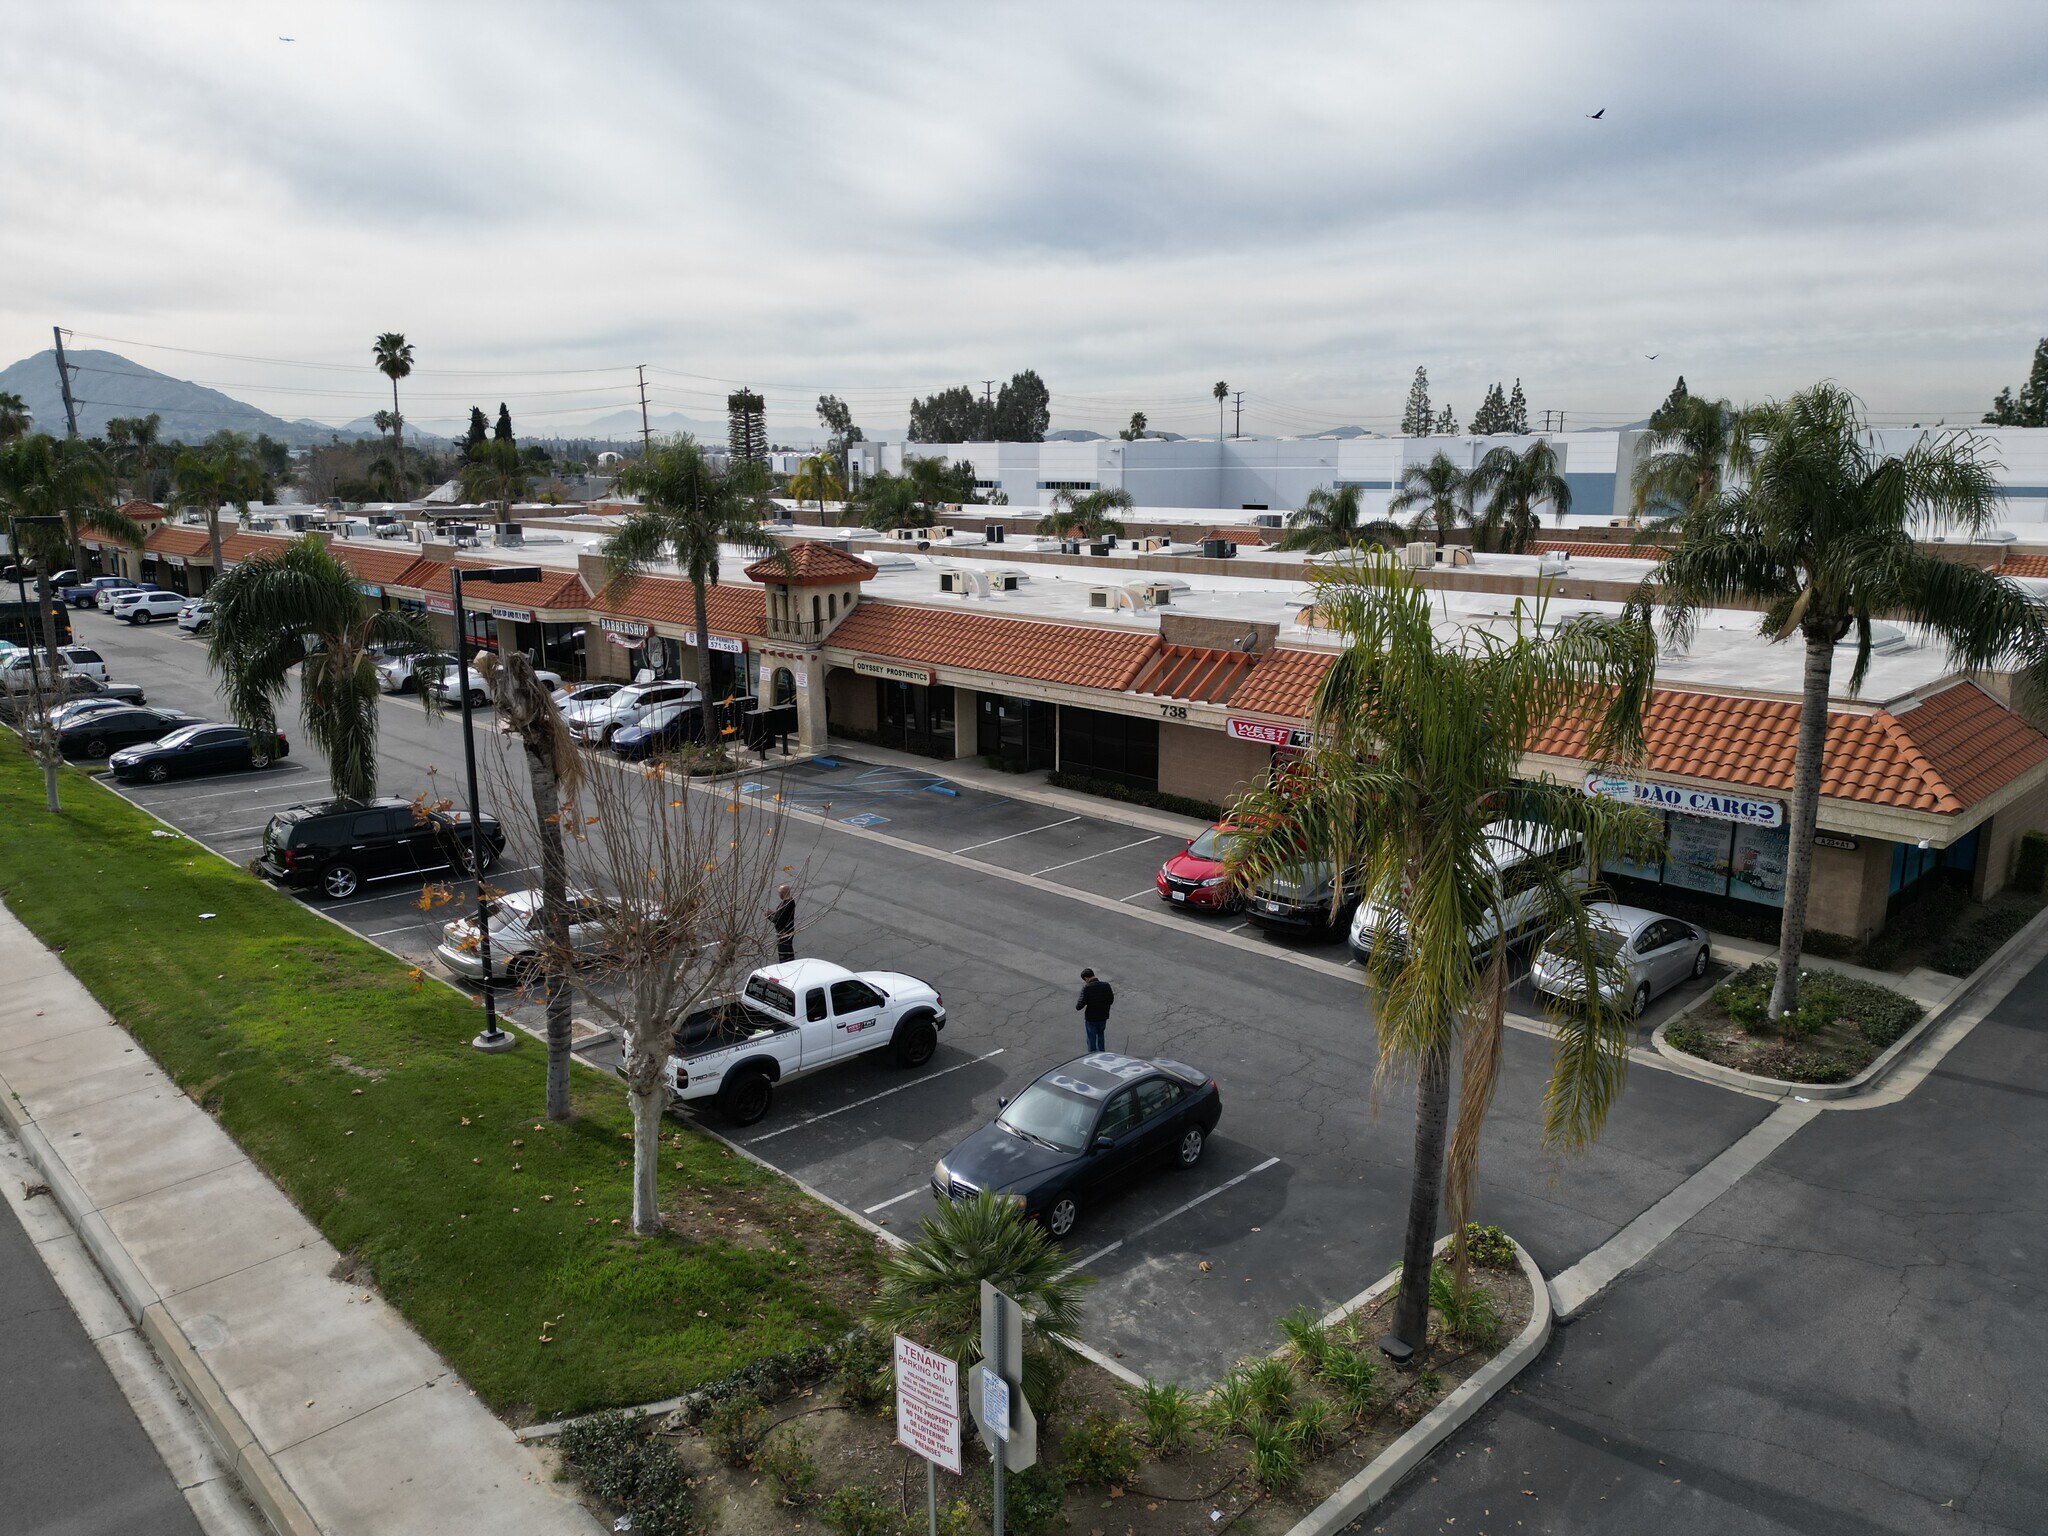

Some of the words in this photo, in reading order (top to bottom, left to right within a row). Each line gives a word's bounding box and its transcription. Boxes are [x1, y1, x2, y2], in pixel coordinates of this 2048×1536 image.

[601, 619, 649, 636] BARBERSHOP
[857, 662, 884, 672] ODYSSEY
[886, 668, 928, 680] PROSTHETICS
[1160, 705, 1187, 718] 738
[1238, 723, 1288, 737] WEST
[1238, 730, 1284, 742] COAST
[1689, 794, 1774, 819] CARGO
[781, 1030, 800, 1040] AUTO
[740, 1041, 760, 1050] HOME
[690, 1074, 708, 1082] TRD
[904, 1344, 947, 1374] TENANT
[898, 1354, 931, 1376] PARKING
[933, 1372, 954, 1386] ONLY
[919, 1383, 931, 1394] TOWED
[926, 1381, 945, 1393] VEHICLES
[902, 1398, 923, 1414] PRIVATE
[924, 1410, 953, 1428] PROPERTY
[905, 1408, 913, 1417] NO
[914, 1412, 950, 1436] TRESPASSING
[909, 1419, 917, 1428] OR
[918, 1424, 946, 1442] LOITERING
[903, 1424, 927, 1441] ALLOWED
[927, 1438, 936, 1446] ON
[936, 1441, 954, 1455] THESE
[915, 1439, 942, 1458] PREMISES
